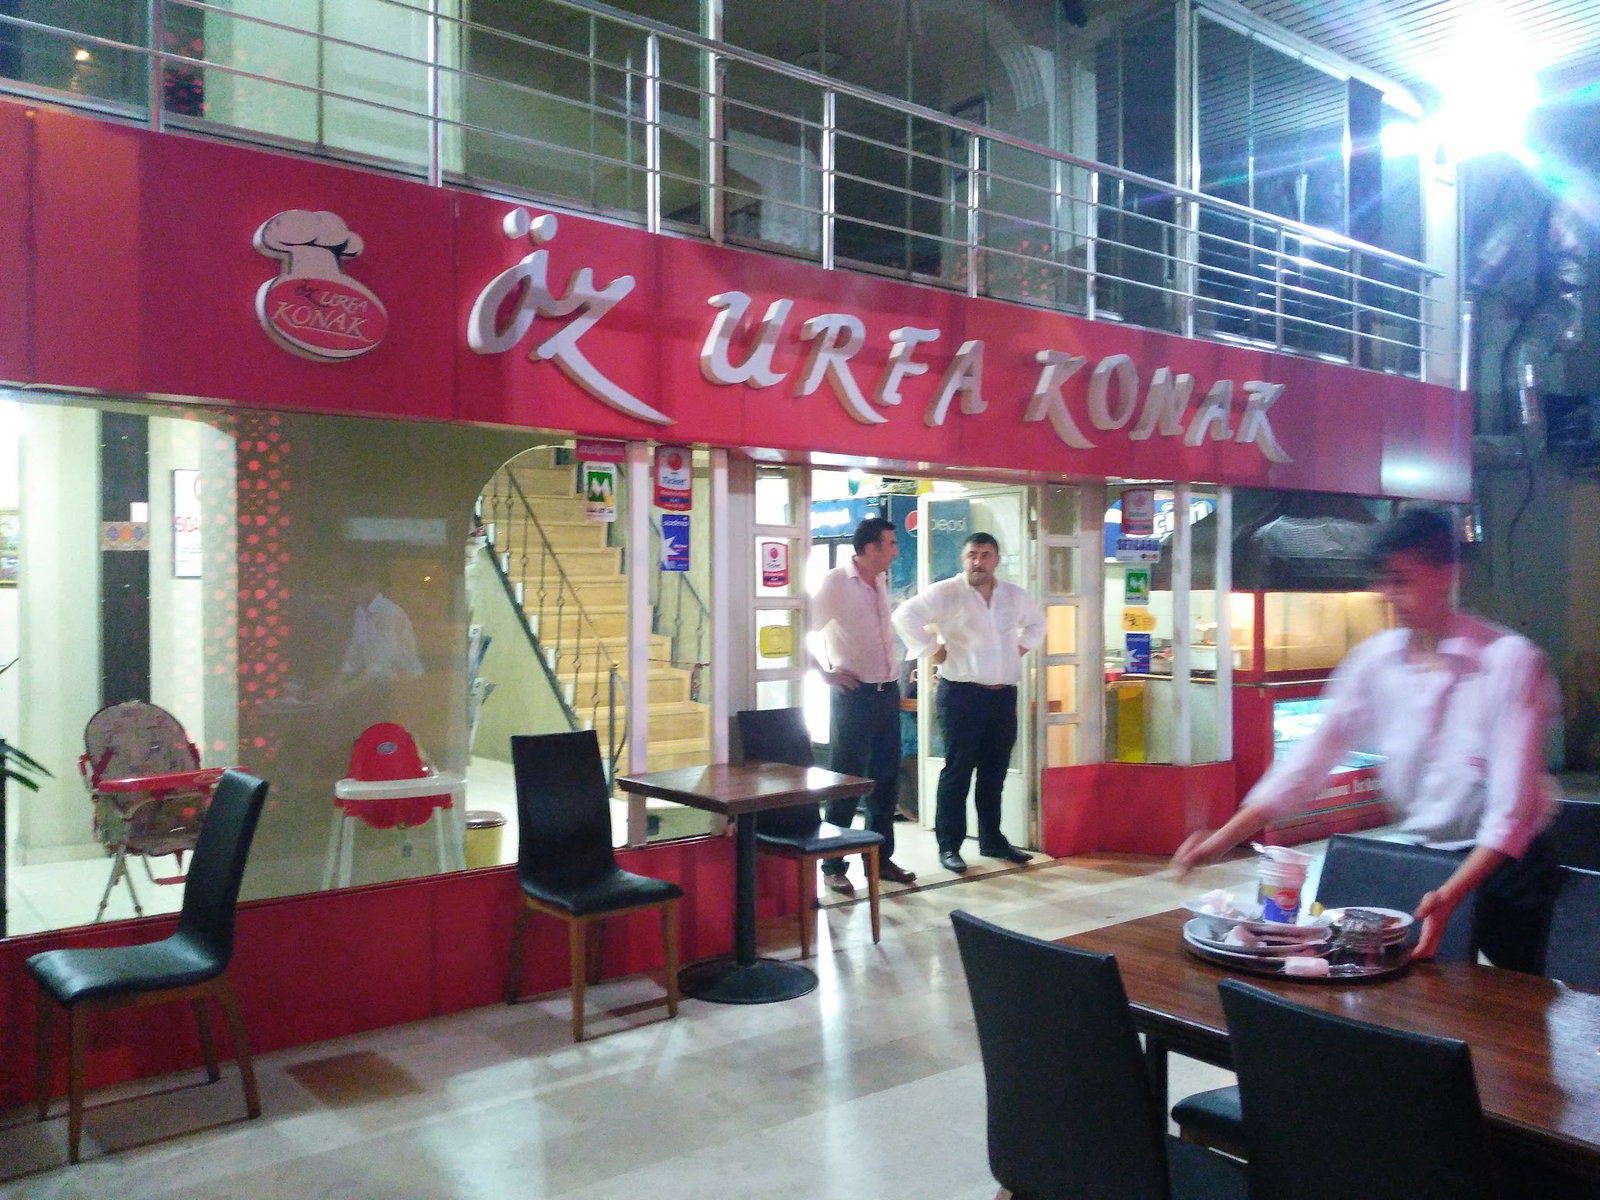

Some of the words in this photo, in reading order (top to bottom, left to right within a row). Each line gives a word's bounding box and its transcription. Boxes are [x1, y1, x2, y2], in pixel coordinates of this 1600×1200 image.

[273, 301, 373, 342] KONAK
[320, 291, 369, 313] URFA
[700, 291, 988, 427] URFA
[1024, 350, 1295, 462] KONAK
